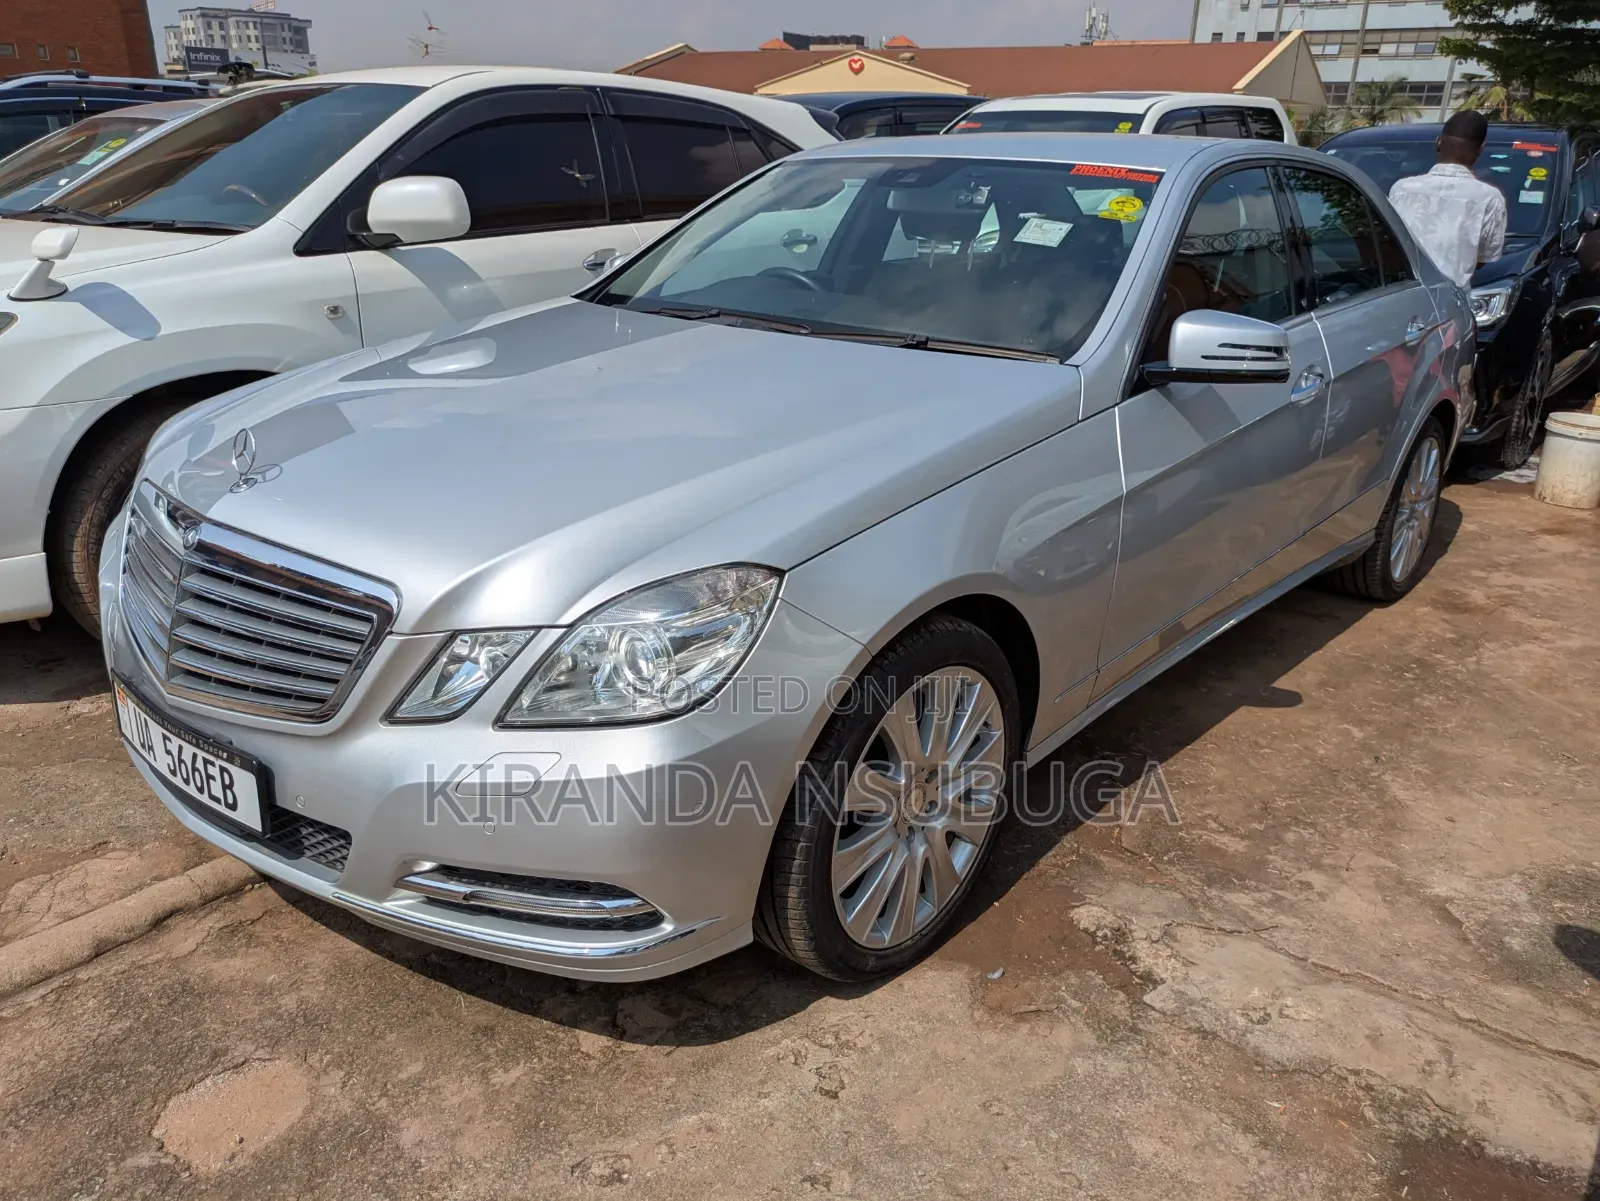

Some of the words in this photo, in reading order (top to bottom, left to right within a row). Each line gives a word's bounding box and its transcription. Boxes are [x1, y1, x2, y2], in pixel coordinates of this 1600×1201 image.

[189, 52, 221, 62] Infinix
[1070, 164, 1128, 178] PHOENIX
[180, 730, 197, 743] Safe
[133, 706, 157, 763] UA
[162, 732, 238, 812] 566EB
